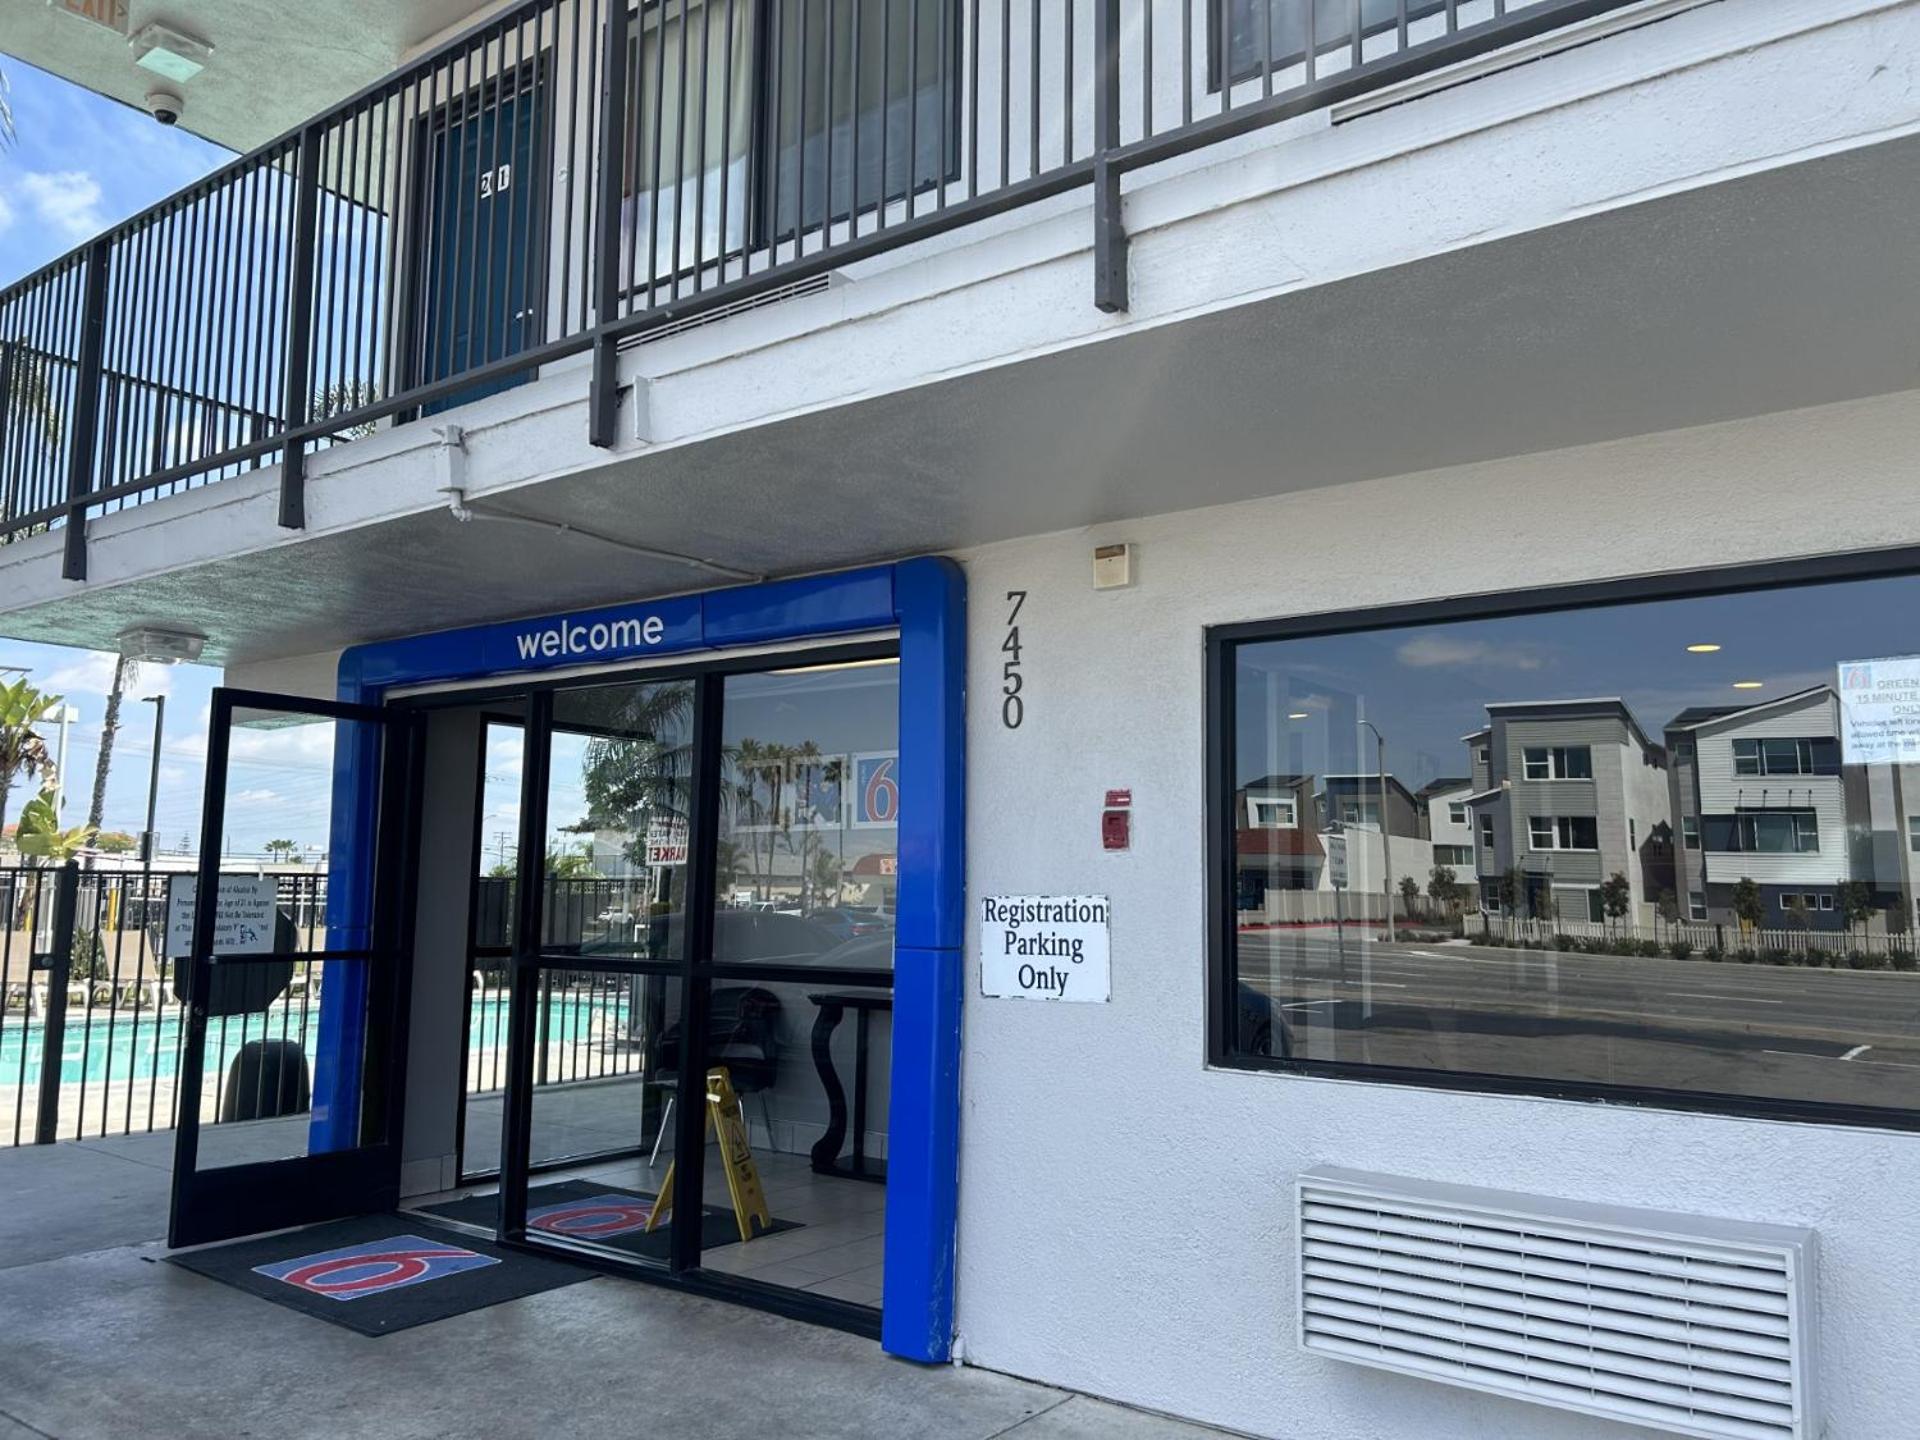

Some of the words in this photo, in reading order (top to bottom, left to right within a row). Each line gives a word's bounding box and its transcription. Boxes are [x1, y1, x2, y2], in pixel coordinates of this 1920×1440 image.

[481, 167, 508, 196] 21
[516, 616, 664, 660] welcome
[1001, 591, 1028, 730] 7450
[865, 758, 898, 823] 6
[984, 898, 1106, 929] Registration
[1004, 930, 1084, 964] Parking
[1018, 963, 1069, 997] Only
